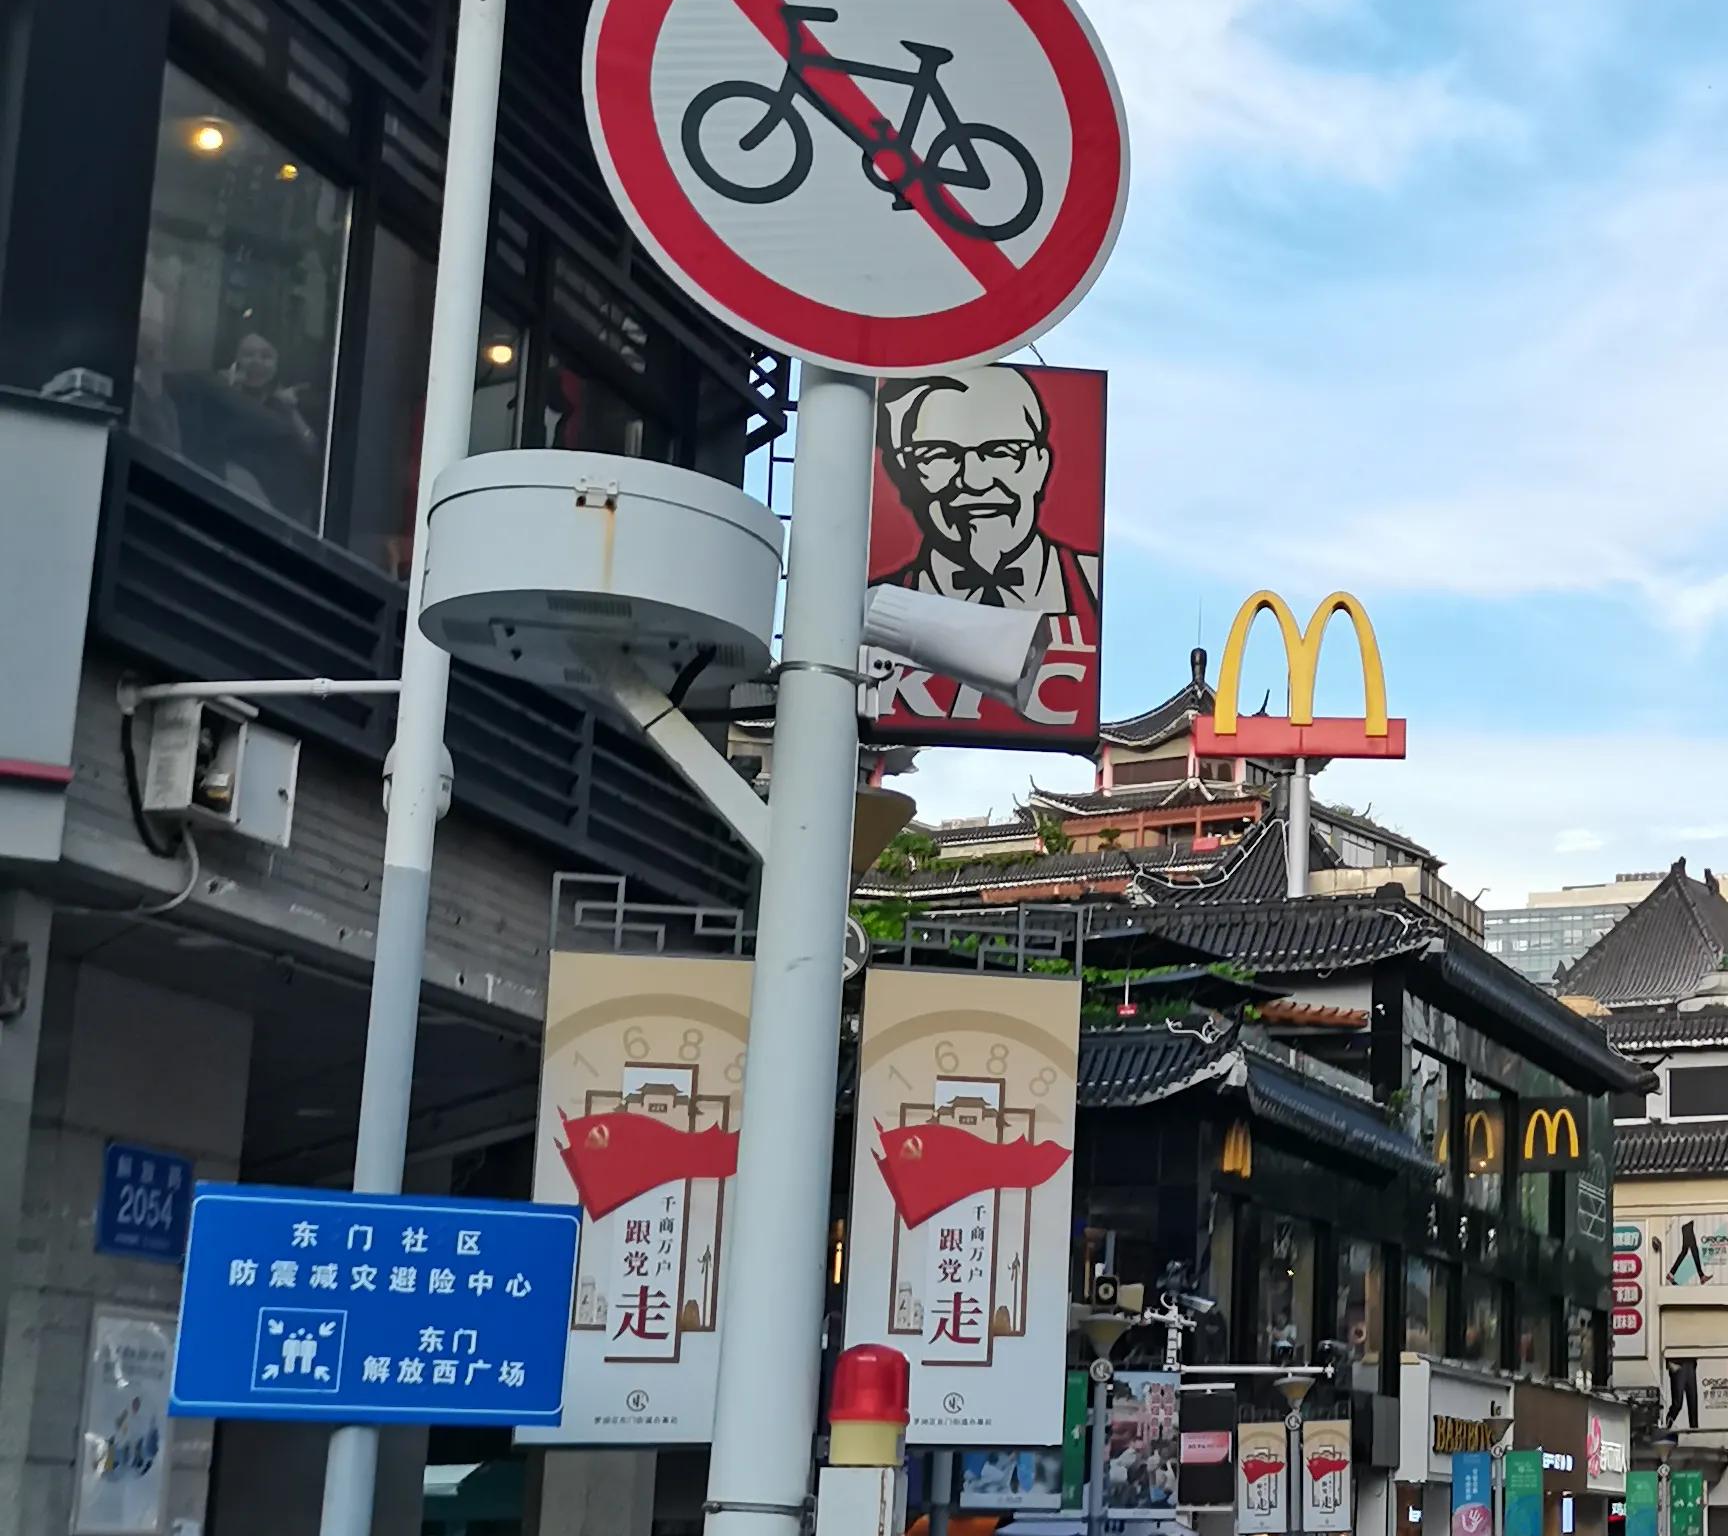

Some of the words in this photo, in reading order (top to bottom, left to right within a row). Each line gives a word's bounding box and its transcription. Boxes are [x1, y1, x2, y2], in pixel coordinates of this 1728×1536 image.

[1214, 590, 1388, 737] M
[1523, 1107, 1580, 1160] M
[117, 1184, 176, 1231] 2054
[291, 1220, 483, 1257] 东门社区
[654, 1194, 677, 1277] 千商万户
[967, 1204, 987, 1282] 千商万户
[228, 1259, 533, 1298] 防震减灾避险中心
[611, 1219, 673, 1342] 跟党走
[928, 1227, 983, 1346] 跟党走
[418, 1326, 478, 1355] 东门
[361, 1355, 526, 1388] 解放西广场
